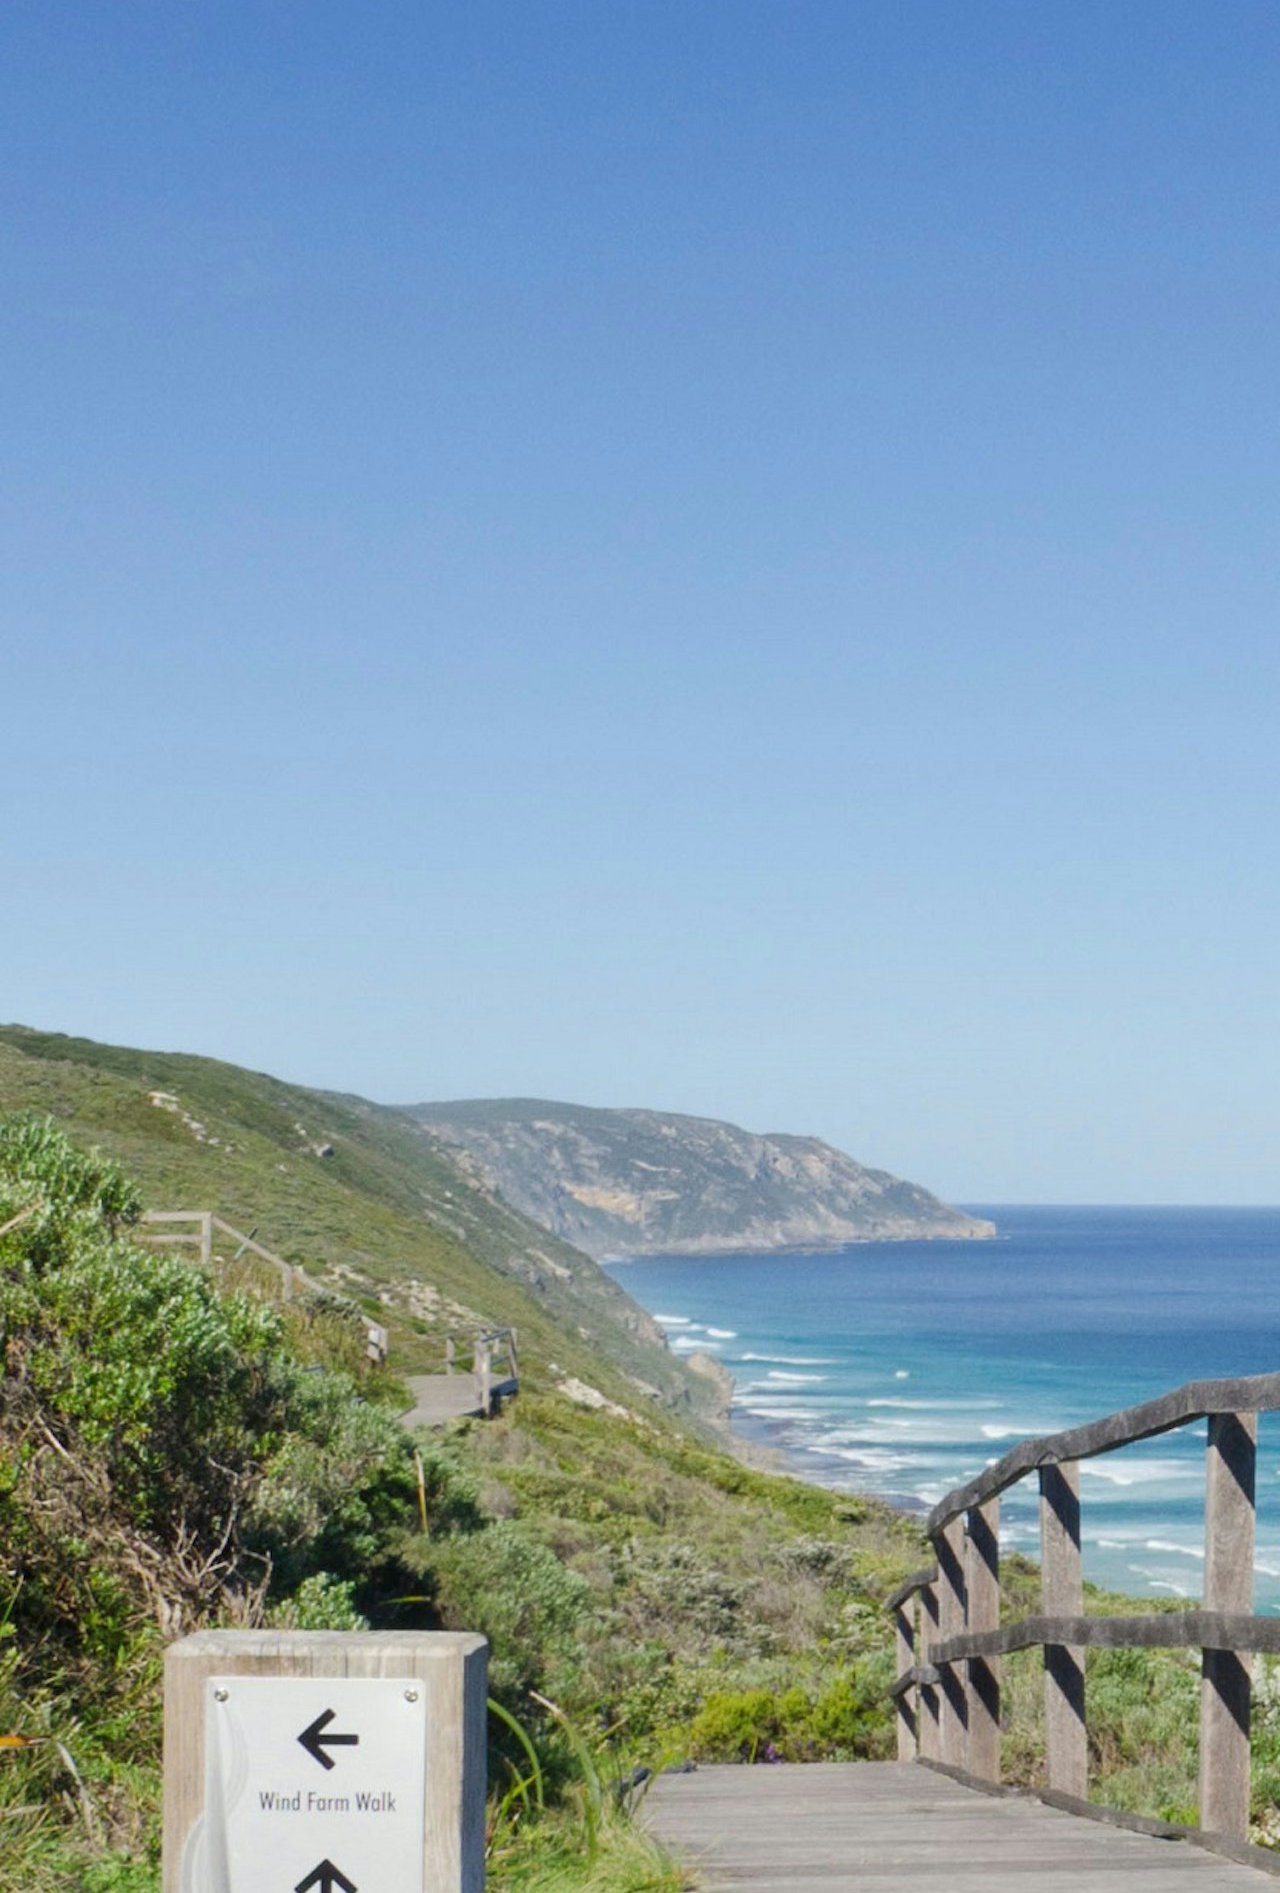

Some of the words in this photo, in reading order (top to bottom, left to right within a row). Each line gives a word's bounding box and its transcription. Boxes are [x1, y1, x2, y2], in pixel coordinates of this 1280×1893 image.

[259, 1791, 301, 1812] Wind
[308, 1792, 350, 1812] Farm
[356, 1792, 397, 1812] Walk
